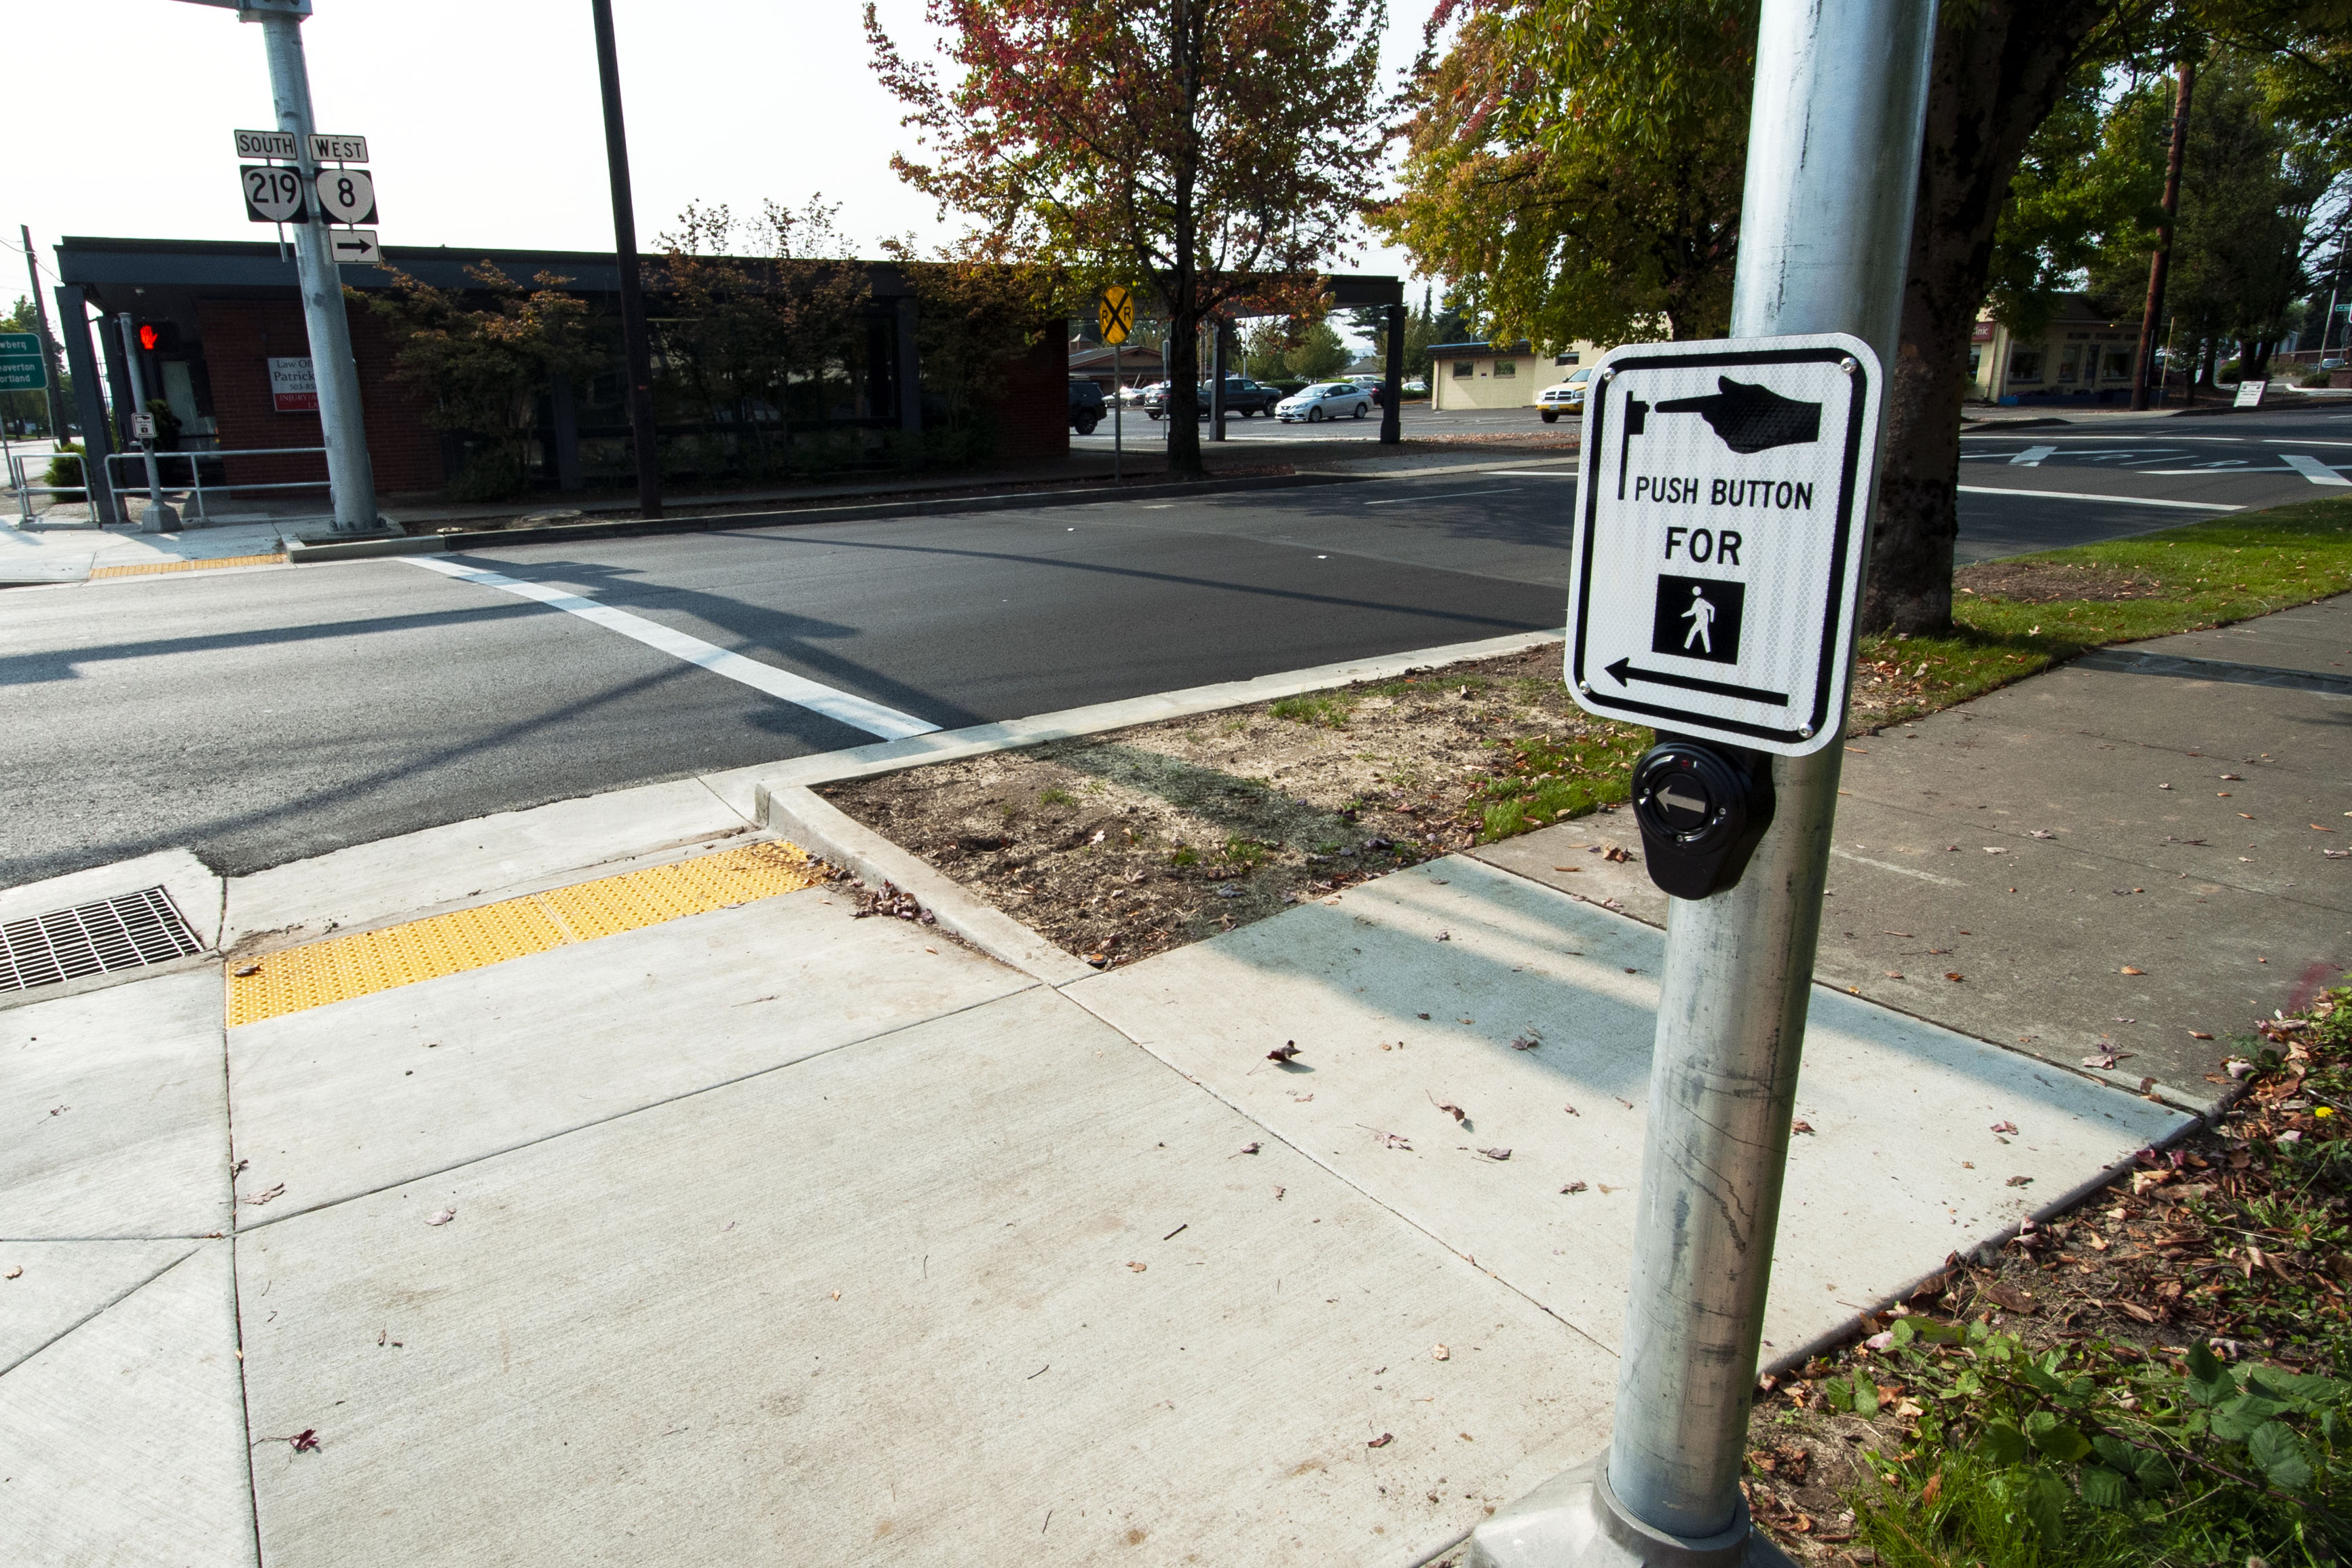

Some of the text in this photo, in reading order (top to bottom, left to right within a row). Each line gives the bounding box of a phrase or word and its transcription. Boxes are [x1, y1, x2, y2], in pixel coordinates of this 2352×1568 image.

[240, 134, 294, 154] SOUTH
[315, 138, 361, 158] WEST
[249, 172, 297, 204] 219
[337, 178, 356, 208] 8
[274, 371, 316, 381] Patrick
[276, 360, 296, 368] Law
[1635, 476, 1814, 510] PUSH BUTTON
[1665, 526, 1742, 566] FOR
